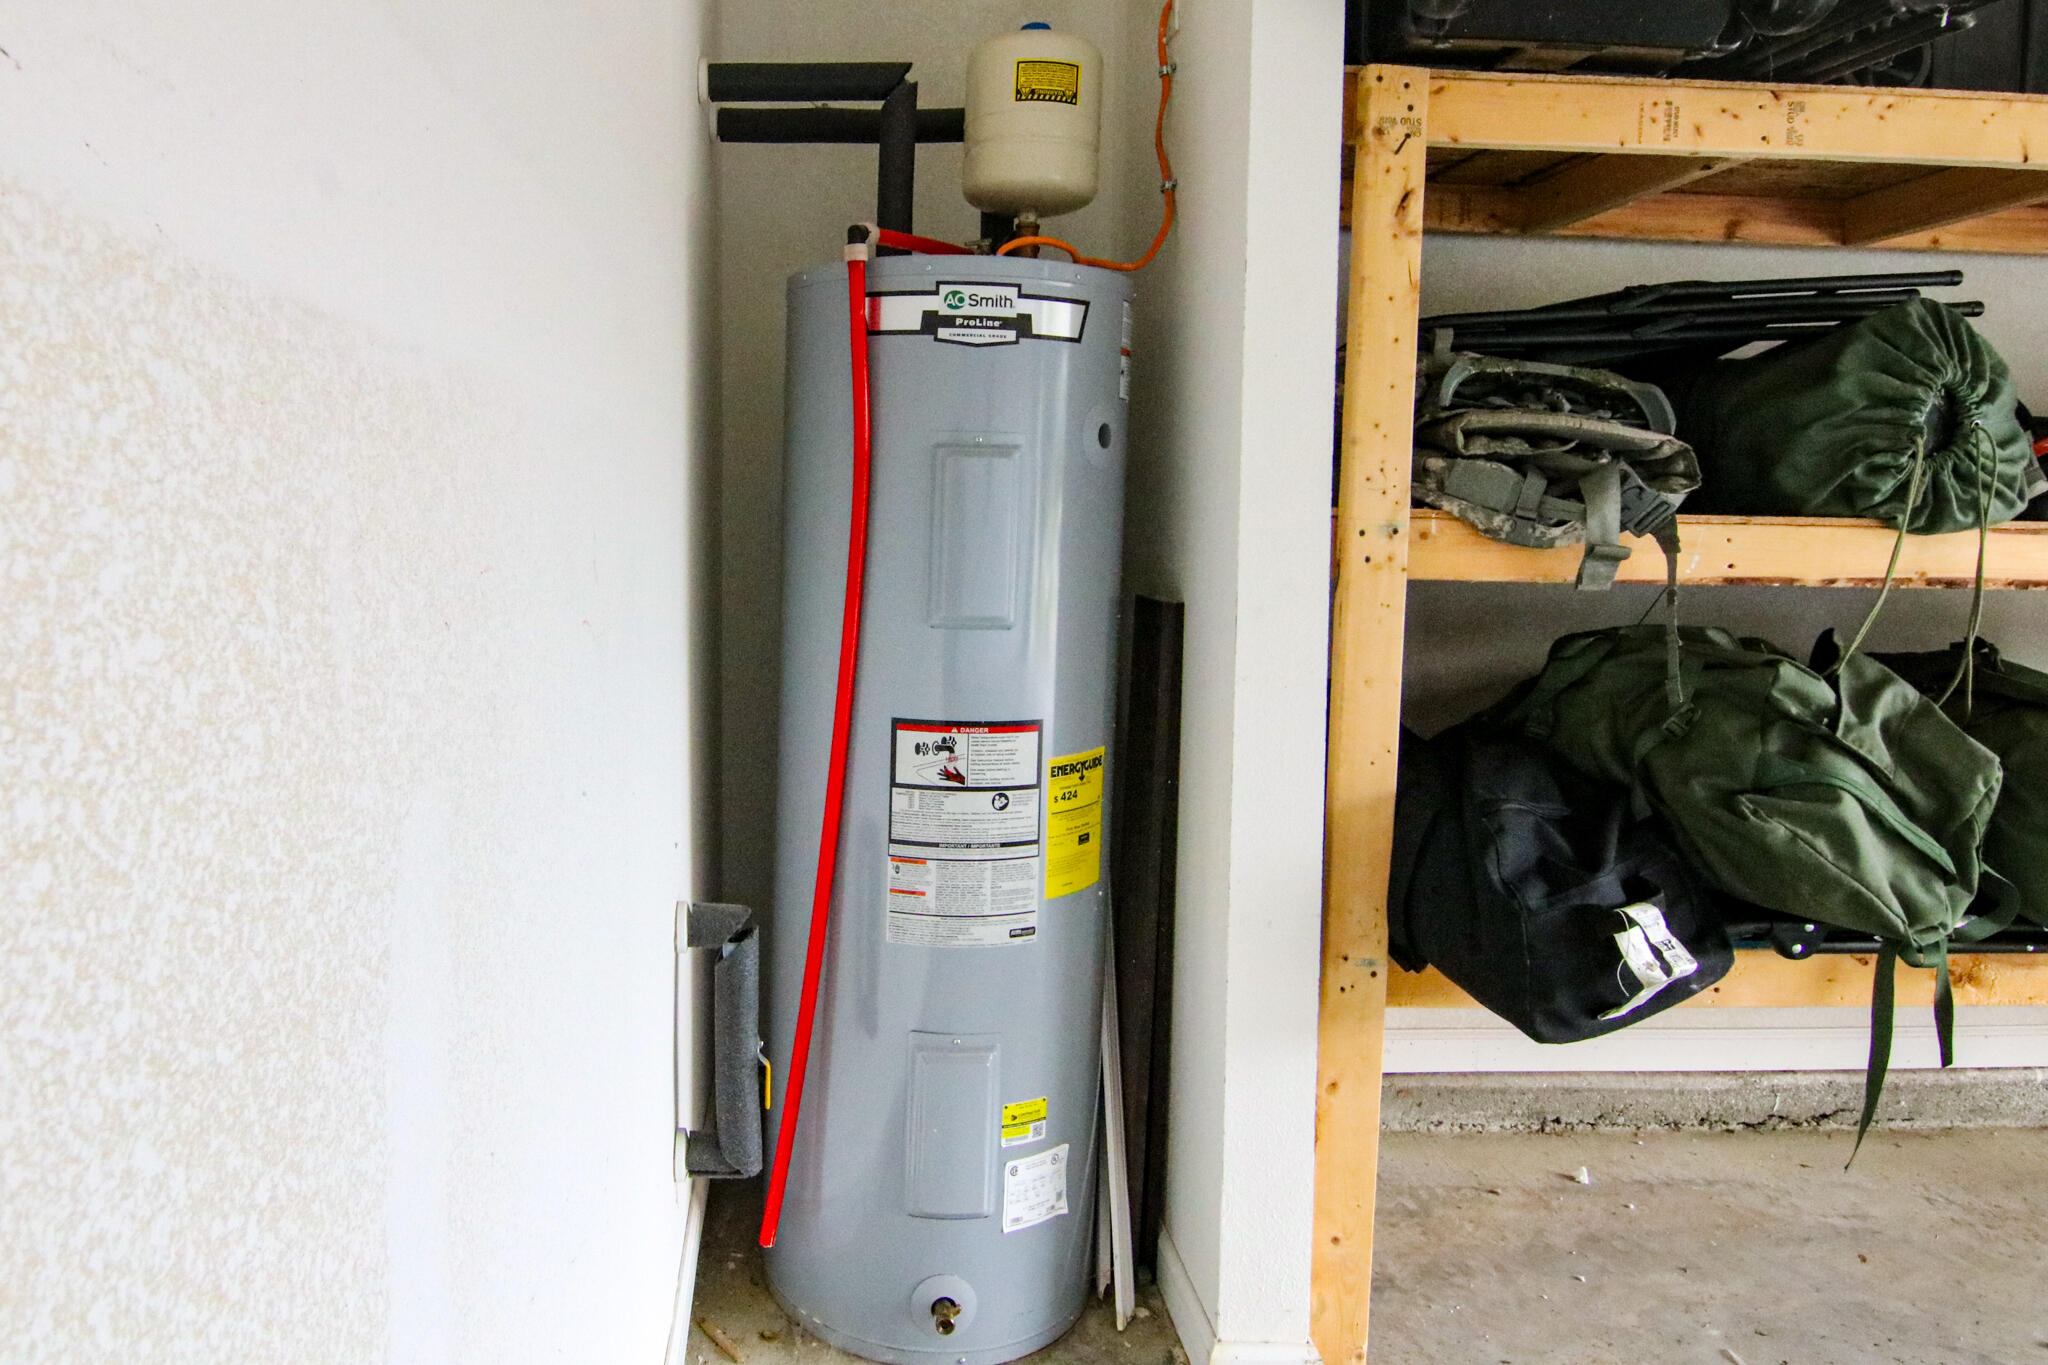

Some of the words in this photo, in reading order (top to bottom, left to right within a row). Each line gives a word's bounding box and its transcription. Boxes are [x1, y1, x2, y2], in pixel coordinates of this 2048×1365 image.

[968, 293, 1013, 309] Smith
[955, 317, 1000, 328] ProLine
[1060, 789, 1078, 801] 424
